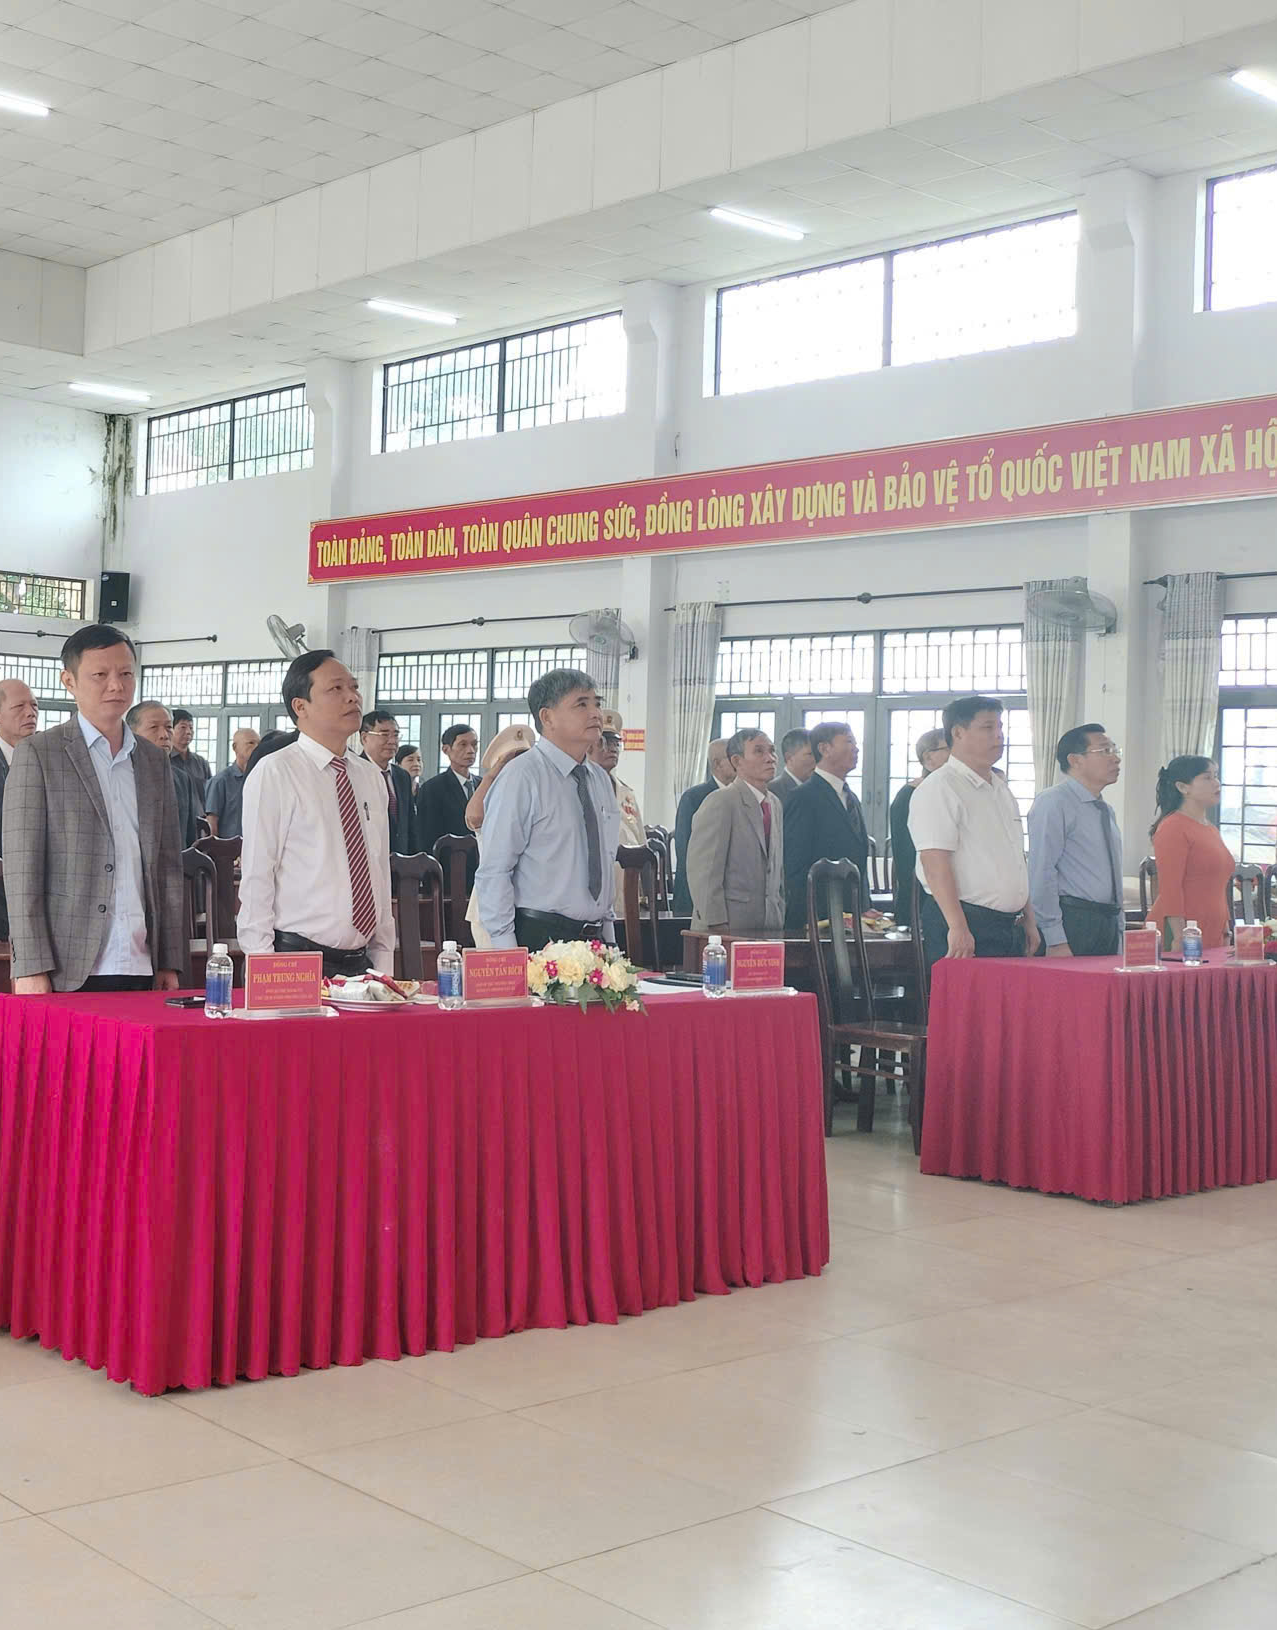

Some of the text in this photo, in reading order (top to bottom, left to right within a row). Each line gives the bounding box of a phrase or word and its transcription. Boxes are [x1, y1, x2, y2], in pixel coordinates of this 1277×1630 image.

[316, 533, 348, 569] TOÀN
[350, 527, 387, 567] ĐẢNG,
[390, 524, 423, 561] TOÀN
[427, 521, 459, 561] DÂN,
[462, 516, 499, 554] TOÀN
[502, 512, 543, 551] QUÂN
[546, 511, 600, 547] CHUNG
[602, 502, 641, 542] SỨC,
[645, 494, 693, 537] ĐỒNG
[697, 489, 746, 531] LÒNG
[749, 484, 787, 526] XÂY
[792, 480, 846, 528] DỰNG
[851, 469, 878, 515] VÀ
[884, 461, 925, 512] BẢO
[932, 460, 959, 513] VỆ
[966, 447, 995, 502] TỔ
[1000, 442, 1063, 502] QUỐC
[1070, 440, 1123, 496] VIỆT
[1129, 437, 1191, 483] NAM
[1199, 424, 1235, 476] XÃ
[273, 972, 295, 983] TRUNG
